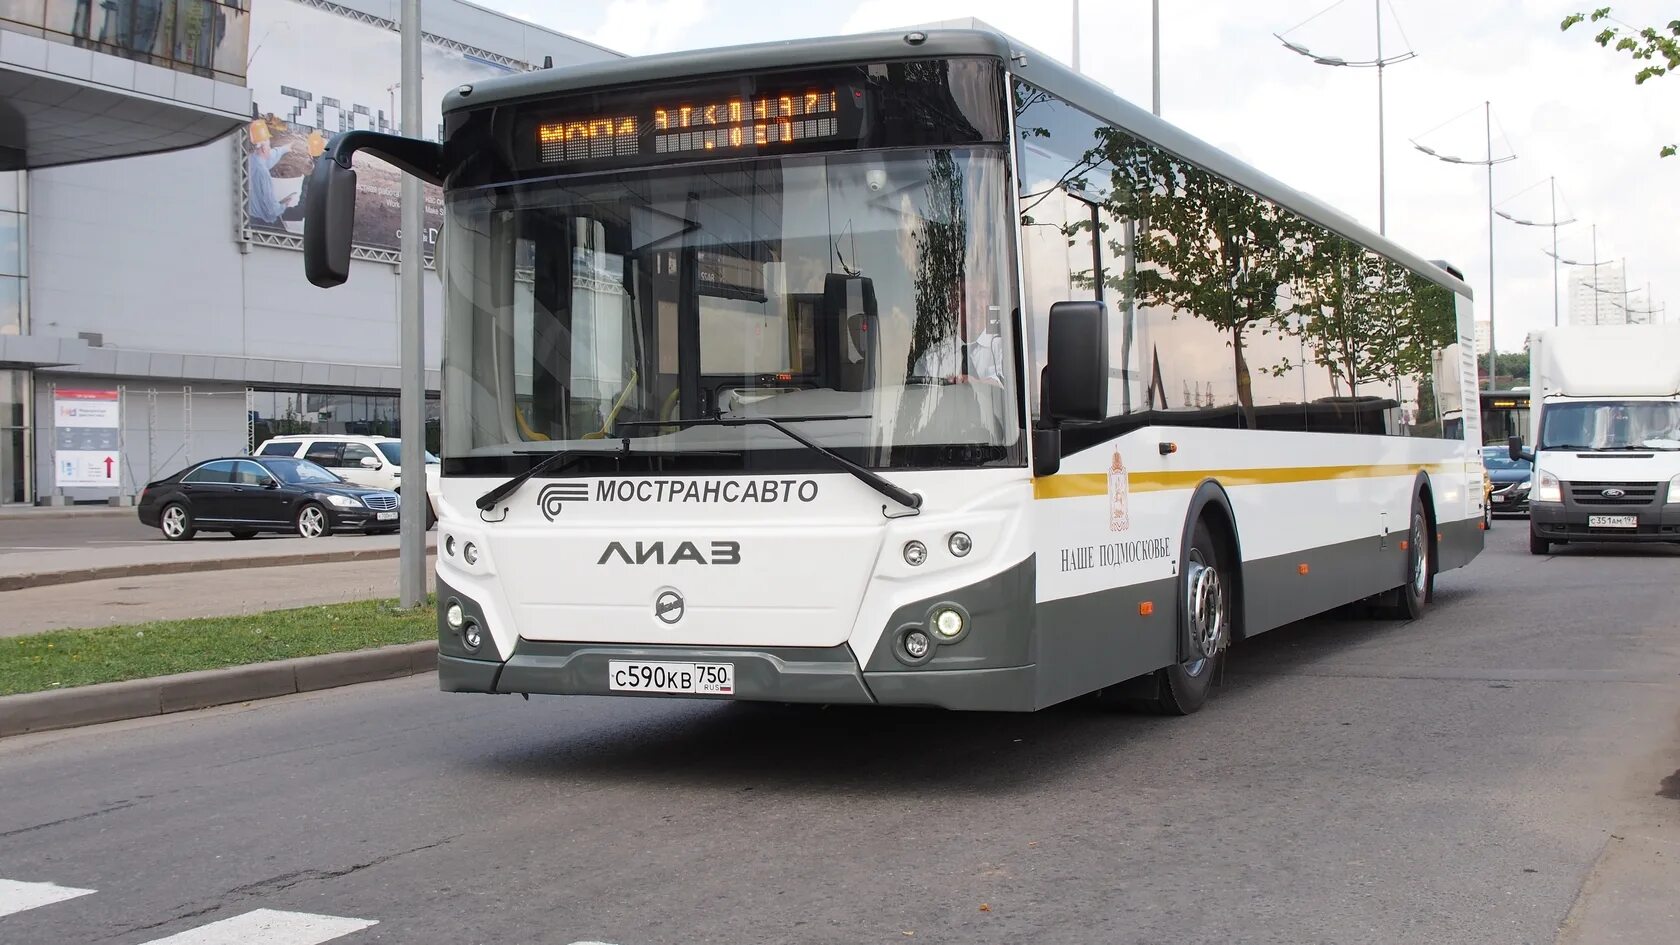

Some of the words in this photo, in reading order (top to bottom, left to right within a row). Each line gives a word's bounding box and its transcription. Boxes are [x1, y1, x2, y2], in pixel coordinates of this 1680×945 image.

[596, 480, 819, 502] МОСТРАНСАВТО
[597, 541, 741, 565] ЛИАЗ
[1061, 546, 1095, 572] НАШЕ
[1099, 537, 1170, 568] ПОДМОСКОВЬЕ
[696, 666, 727, 684] 750
